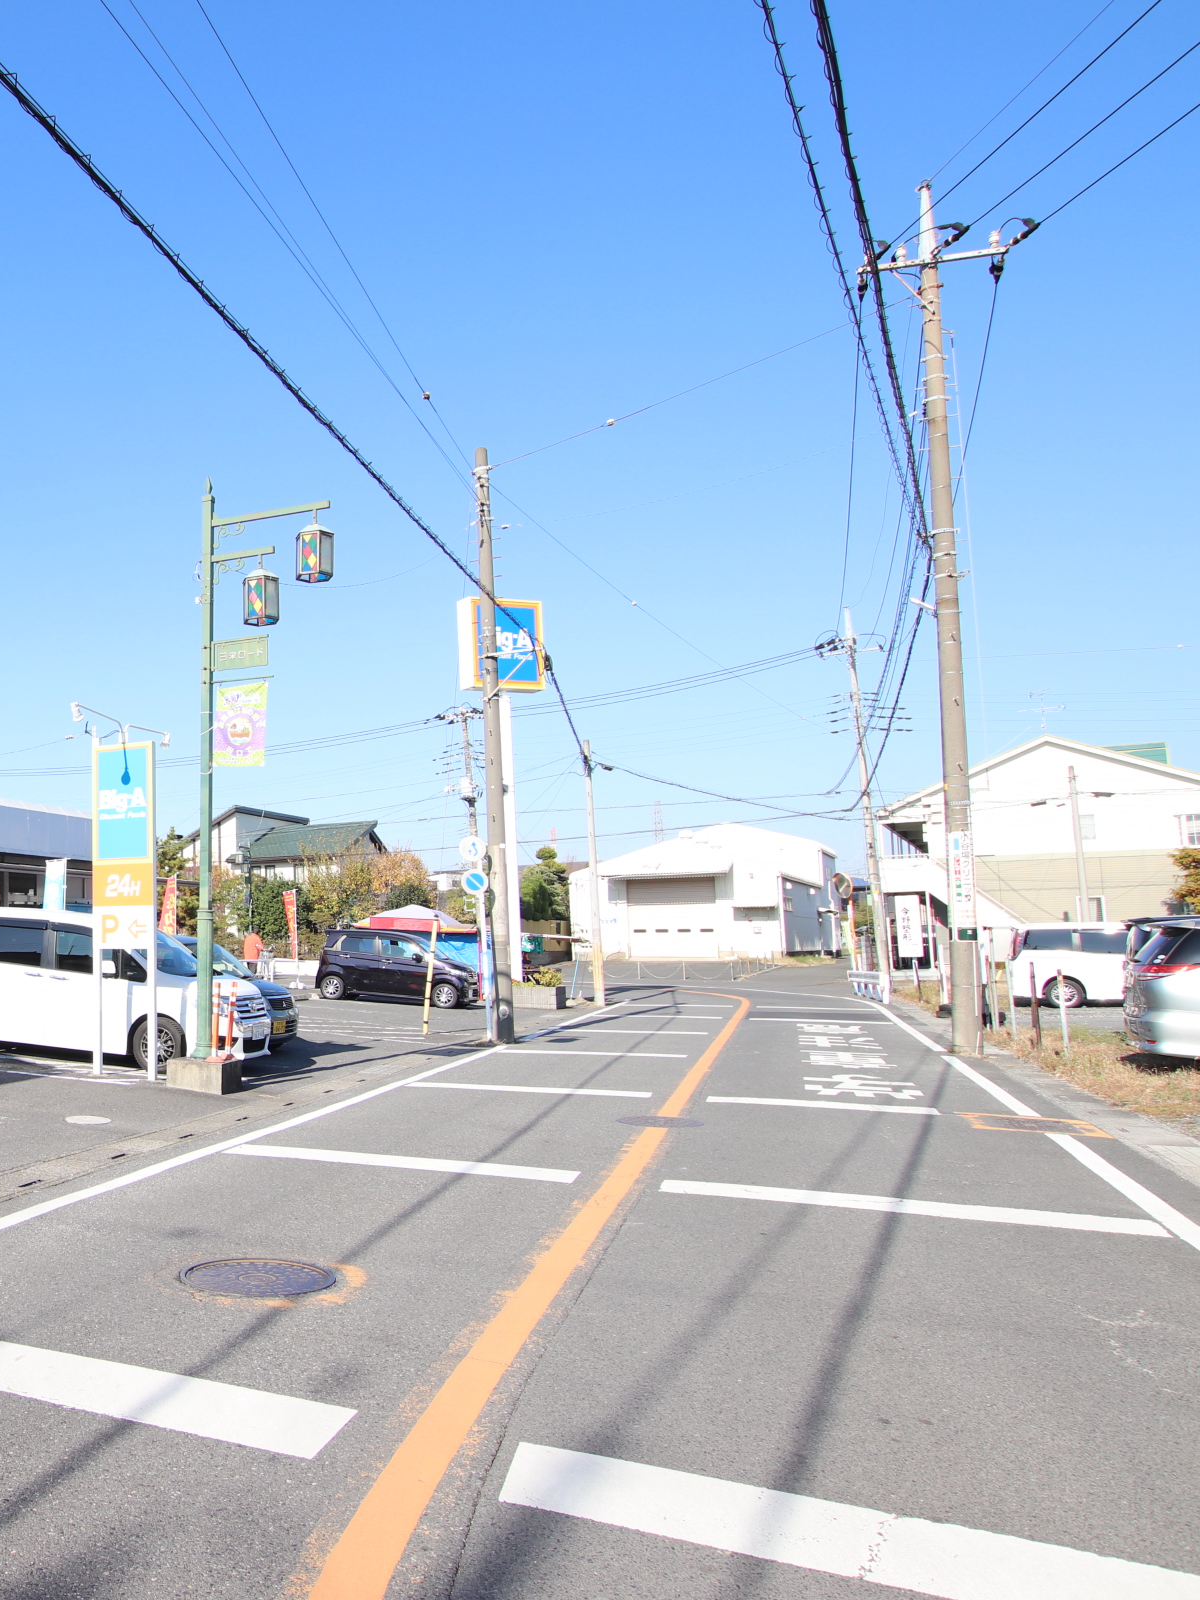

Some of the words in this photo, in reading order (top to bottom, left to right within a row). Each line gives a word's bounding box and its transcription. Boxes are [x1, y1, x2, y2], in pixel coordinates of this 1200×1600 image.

[495, 626, 533, 652] ig-A
[219, 648, 264, 662] 三栄ロード
[99, 787, 147, 813] Big-A
[100, 812, 126, 820] Discount
[127, 811, 147, 819] Foods
[102, 914, 119, 943] P
